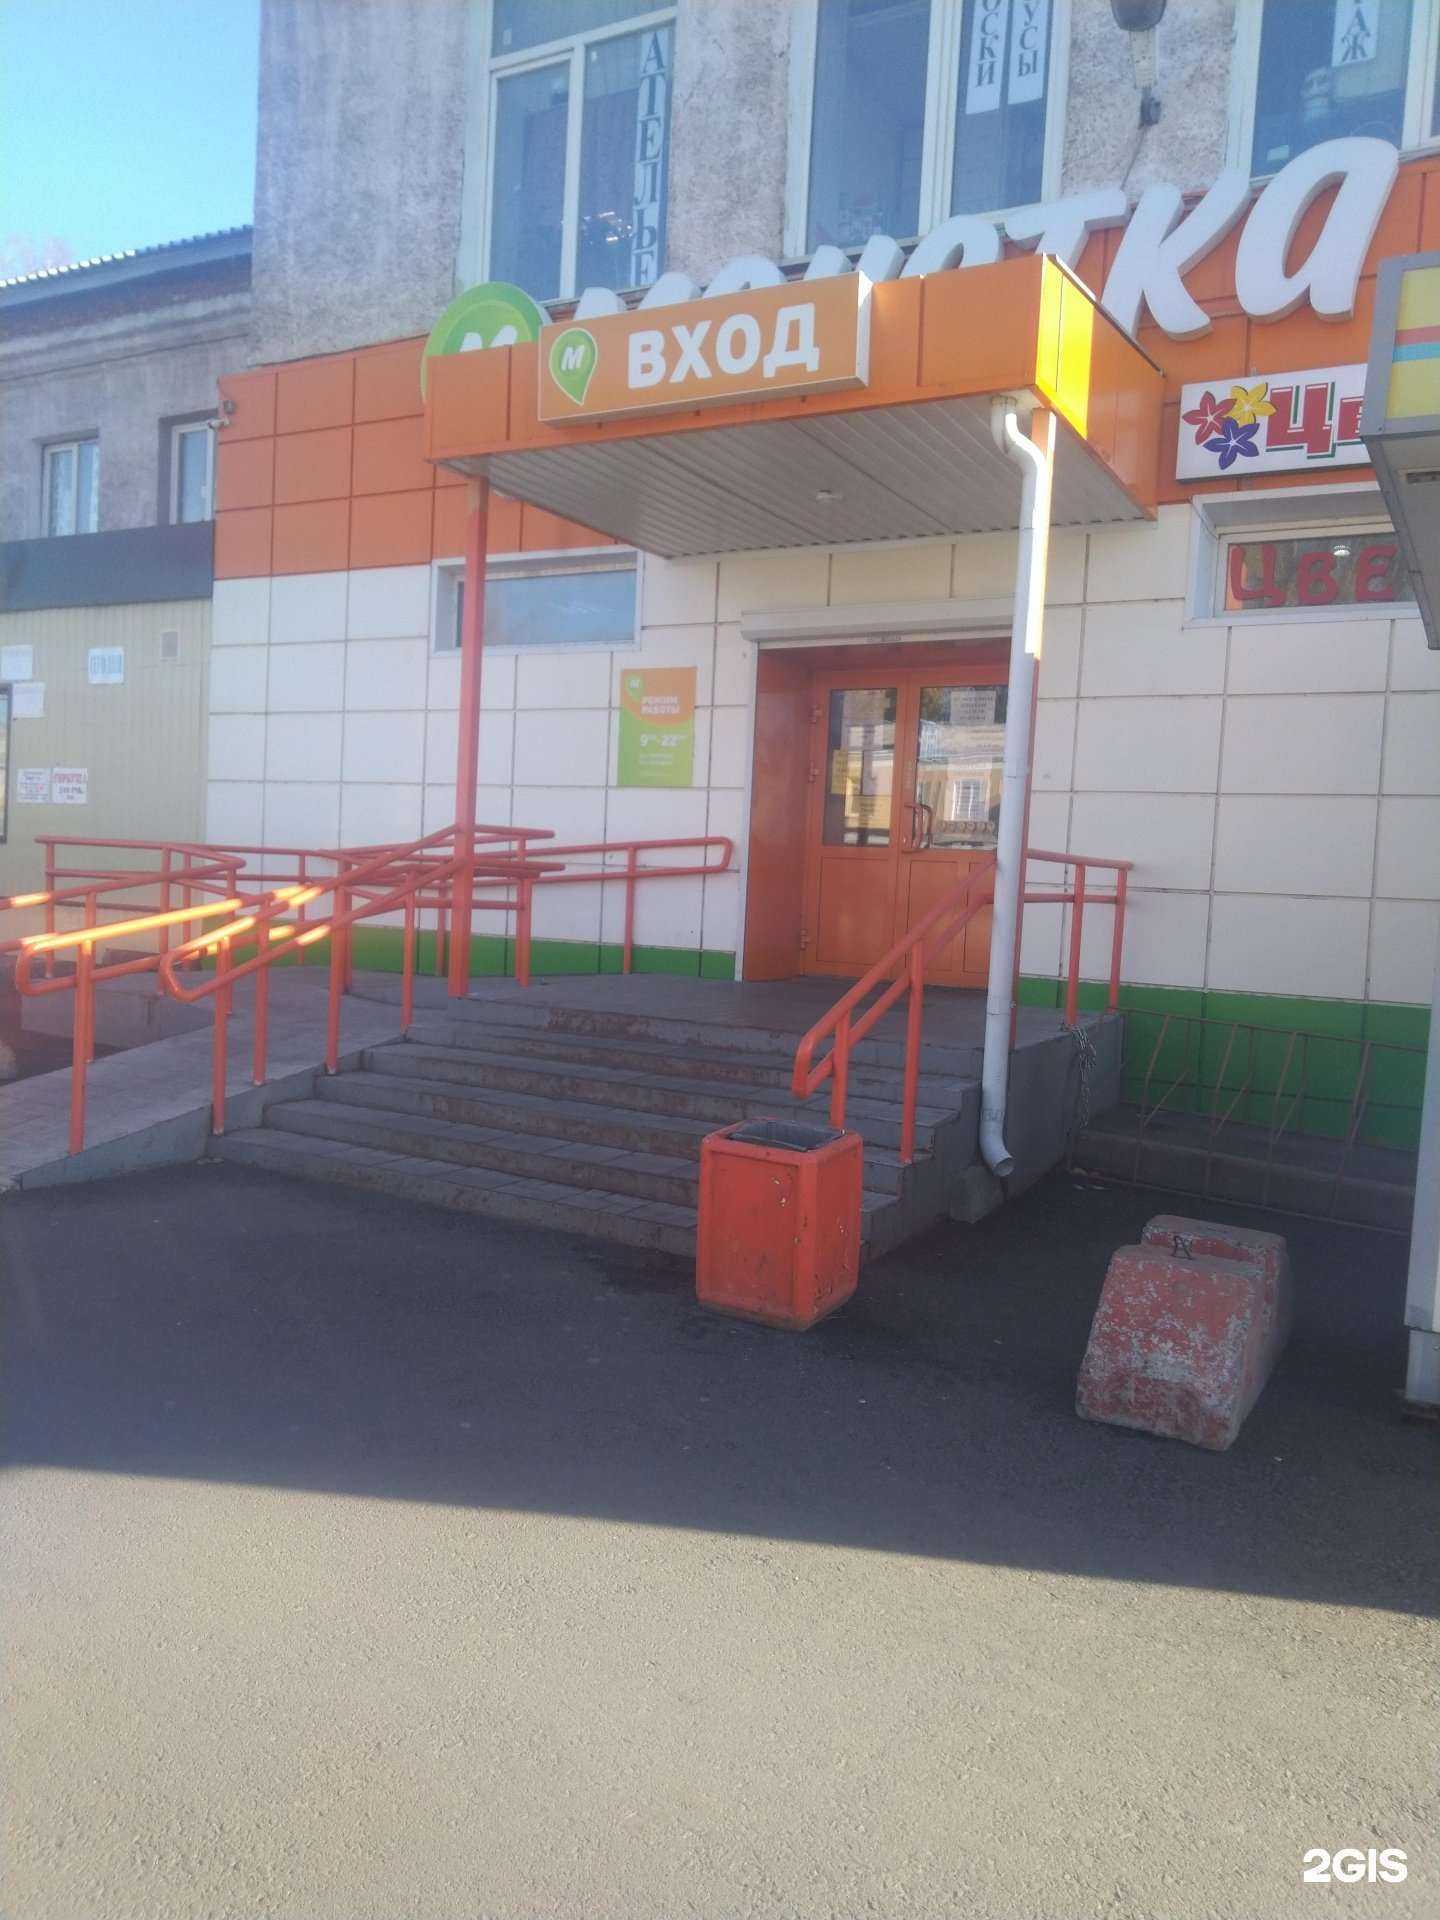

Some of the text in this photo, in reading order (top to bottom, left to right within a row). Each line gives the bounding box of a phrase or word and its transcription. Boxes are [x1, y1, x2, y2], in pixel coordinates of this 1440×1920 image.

[1018, 0, 1040, 77] УСЫ
[1341, 0, 1371, 62] АЖ
[627, 302, 820, 389] ВХОД
